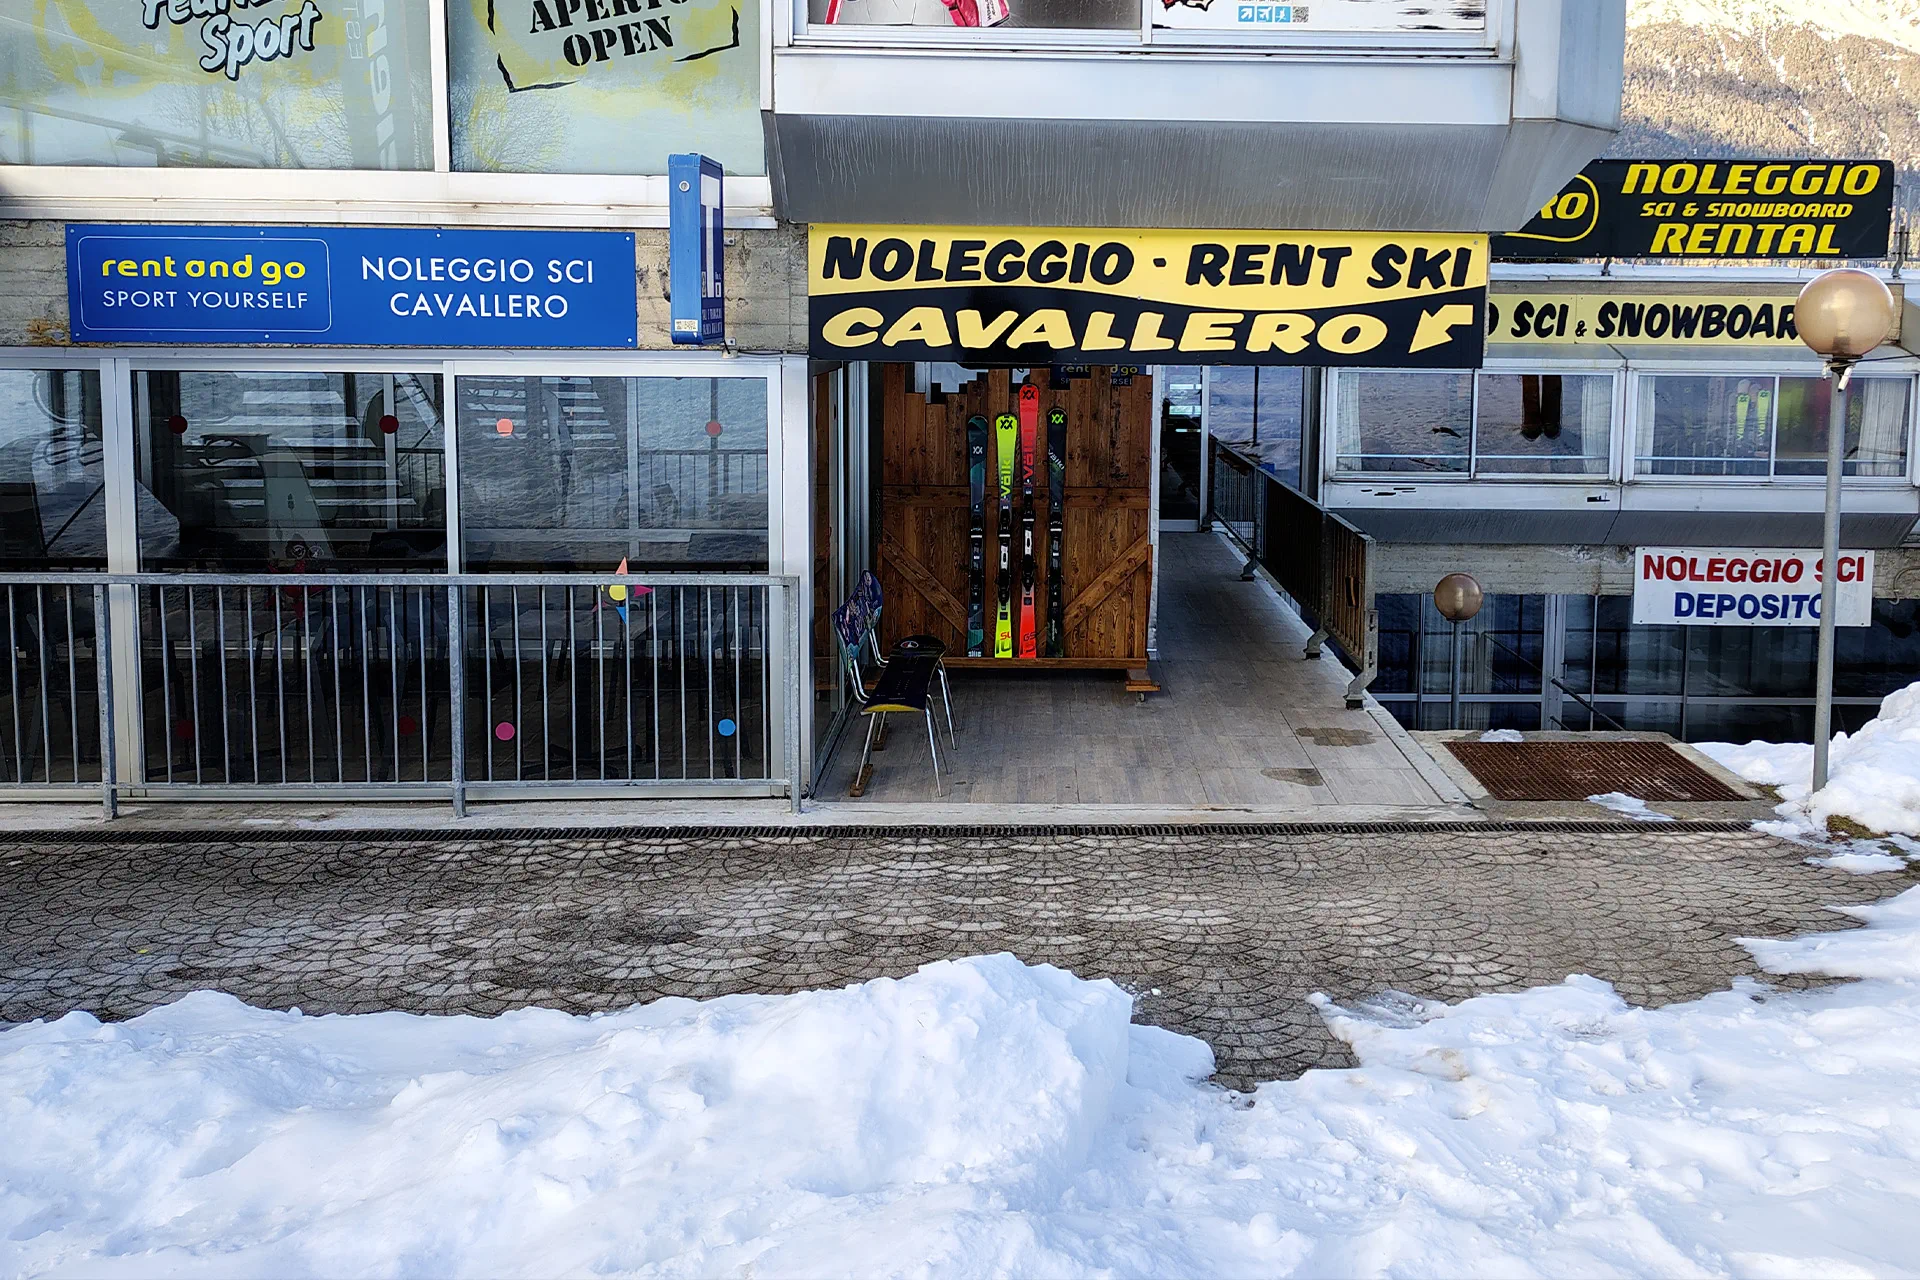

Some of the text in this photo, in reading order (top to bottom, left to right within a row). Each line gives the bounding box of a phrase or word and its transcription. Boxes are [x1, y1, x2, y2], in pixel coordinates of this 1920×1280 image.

[200, 1, 322, 81] Sport
[563, 16, 674, 66] OPEN
[1621, 164, 1880, 195] NOLEGGIO
[1640, 202, 1853, 218] SCI & SNOWBOARD
[1650, 223, 1840, 254] RENTAL
[102, 255, 306, 285] rent and go
[362, 256, 593, 283] NOLEGGIO SCI
[822, 236, 1135, 285] NOLEGGIO
[1185, 243, 1352, 288] RENT
[1366, 243, 1472, 289] SKI
[103, 290, 308, 309] SPORT YOURSELF
[389, 292, 569, 319] CAVALLERO
[822, 306, 1388, 354] CAVALLERO
[1510, 300, 1569, 338] SCI
[1575, 320, 1588, 337] &
[1595, 301, 1800, 340] SNOWBOAR
[1643, 555, 1804, 583] NOLEGGIO
